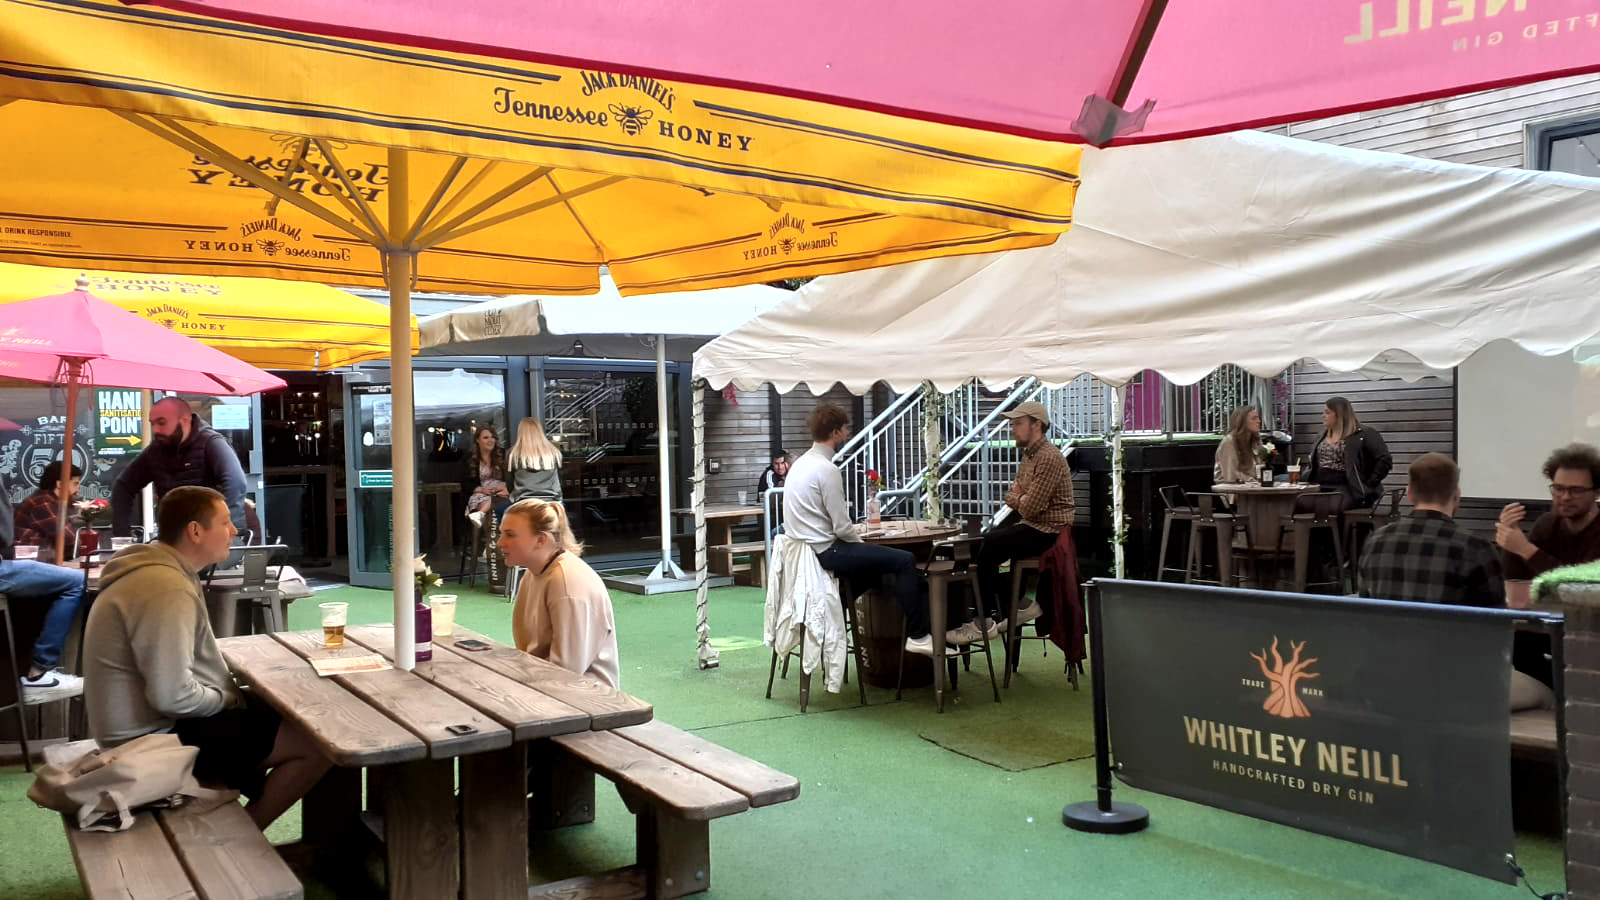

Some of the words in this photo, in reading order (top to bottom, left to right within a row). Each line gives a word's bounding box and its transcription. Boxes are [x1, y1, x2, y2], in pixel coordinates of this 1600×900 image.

[580, 70, 618, 96] JACK
[493, 86, 609, 127] Tennessee
[658, 119, 754, 151] HONEY
[5, 227, 26, 235] DRINK
[181, 322, 225, 331] HONEY
[100, 409, 142, 417] SANITISATI
[33, 433, 76, 445] FIFT
[1242, 678, 1265, 689] TRADE
[1303, 687, 1323, 697] MARK
[1183, 715, 1306, 767] WHITLEY
[1318, 741, 1409, 788] NEILL
[1213, 759, 1305, 790] HANDCRAFTED
[1313, 780, 1341, 797] DRY
[1349, 788, 1374, 805] GIN
